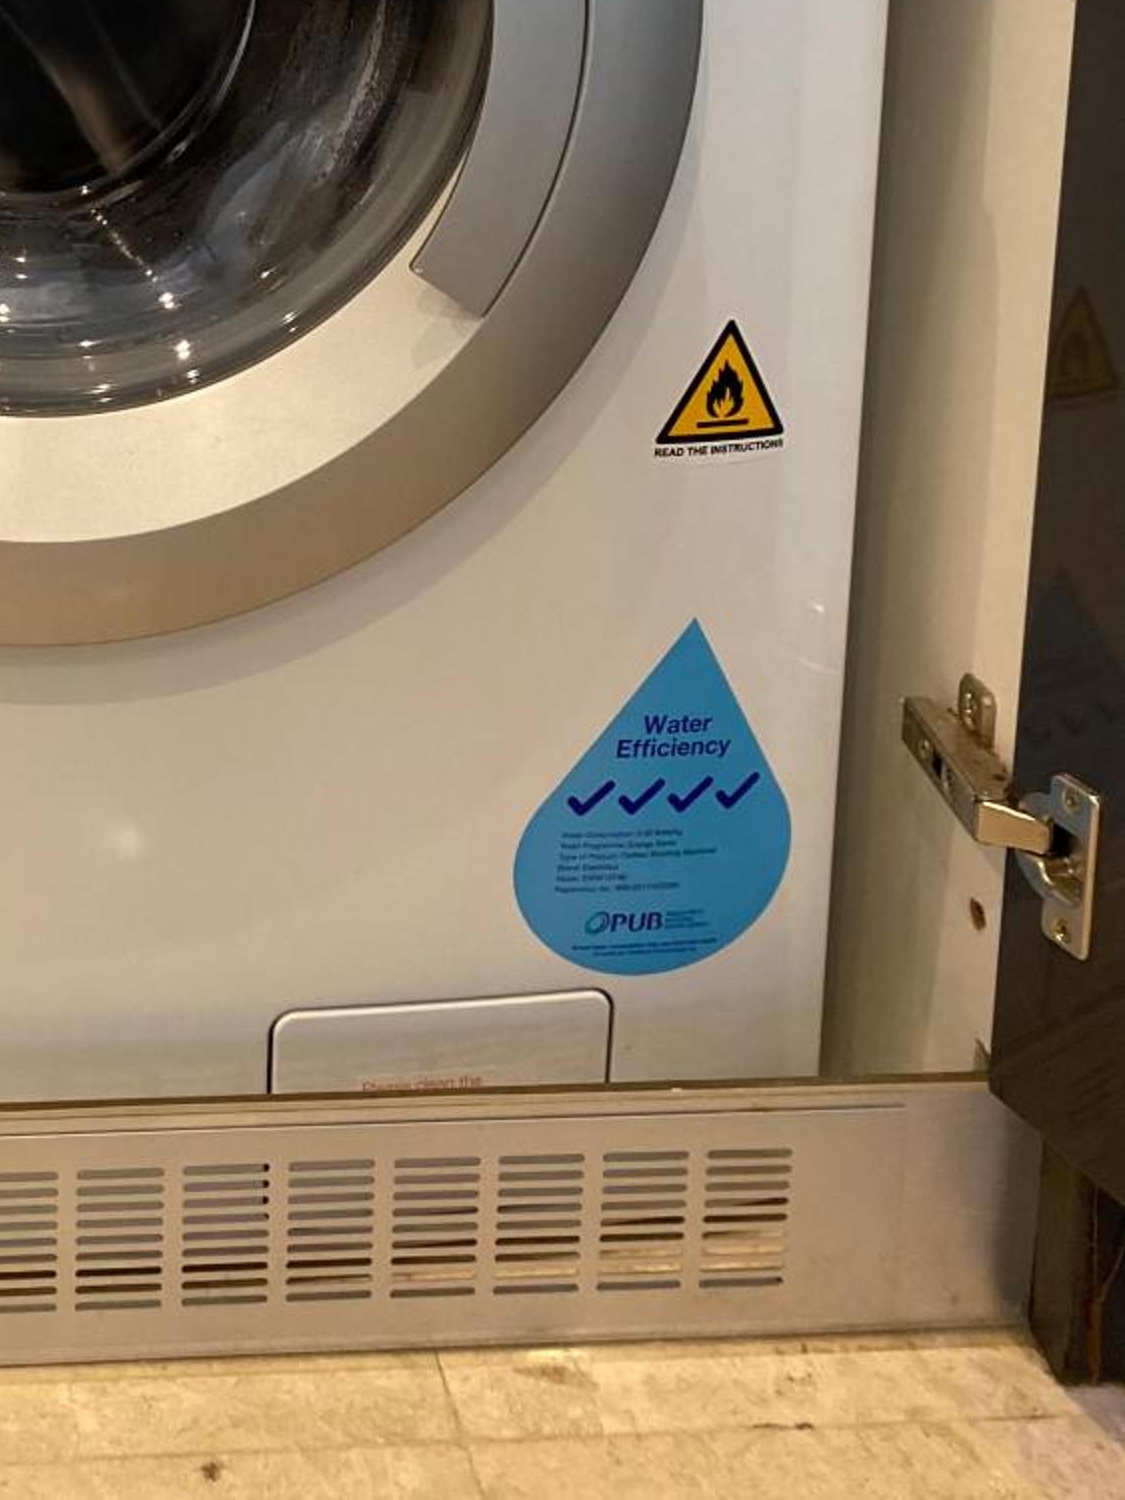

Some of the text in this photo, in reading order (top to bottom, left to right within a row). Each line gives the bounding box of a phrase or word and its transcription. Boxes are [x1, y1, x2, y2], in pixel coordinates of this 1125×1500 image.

[654, 439, 783, 457] READ THE INSTRUCTIONS
[644, 715, 713, 734] Water
[616, 738, 731, 758] Efficiency
[610, 911, 663, 933] PUB
